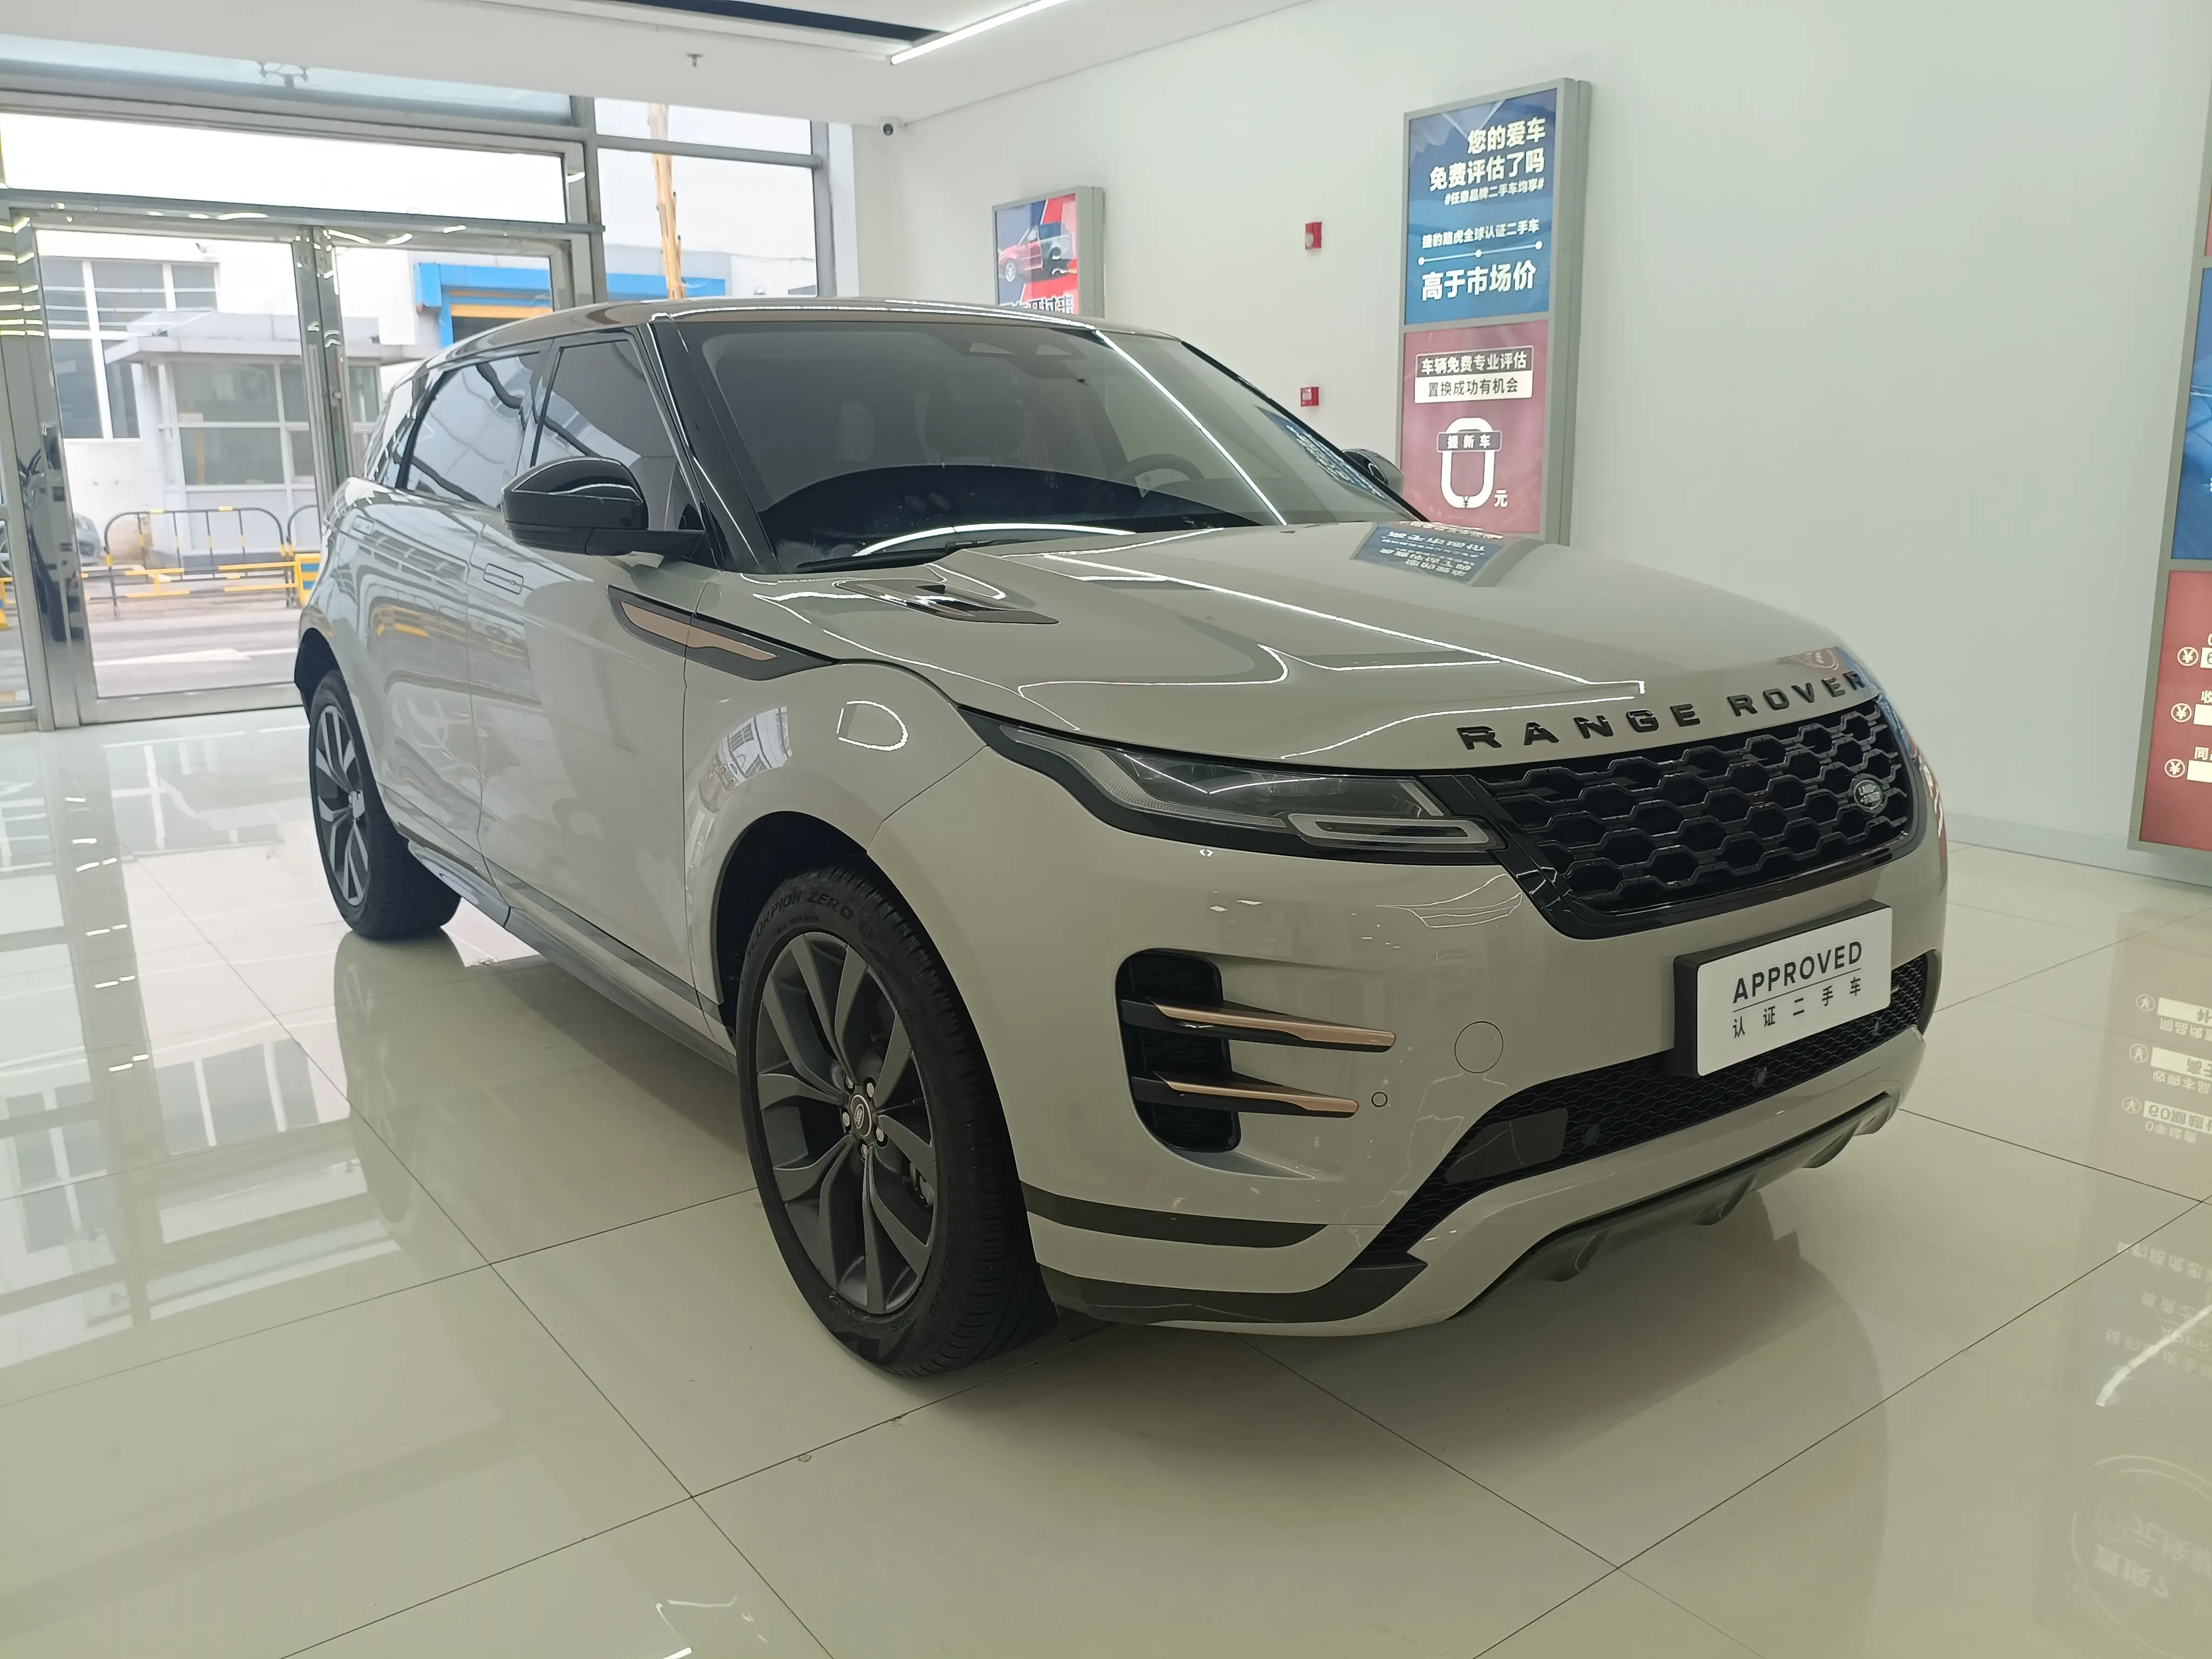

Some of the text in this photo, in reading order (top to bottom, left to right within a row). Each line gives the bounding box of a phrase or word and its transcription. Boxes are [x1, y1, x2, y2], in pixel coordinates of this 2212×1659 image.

[1467, 117, 1546, 154] 您的爱车
[1429, 148, 1545, 192] 免费评估了吗
[1422, 260, 1536, 301] 高于市场价
[1421, 352, 1527, 375] 车辆免费专业评估
[1428, 377, 1519, 397] 置换成功有机会
[1456, 670, 1866, 751] RANGE ROVER
[806, 891, 854, 920] ZERO
[1732, 941, 1862, 1003] APPROVED
[1732, 976, 1862, 1038] 认证二手车
